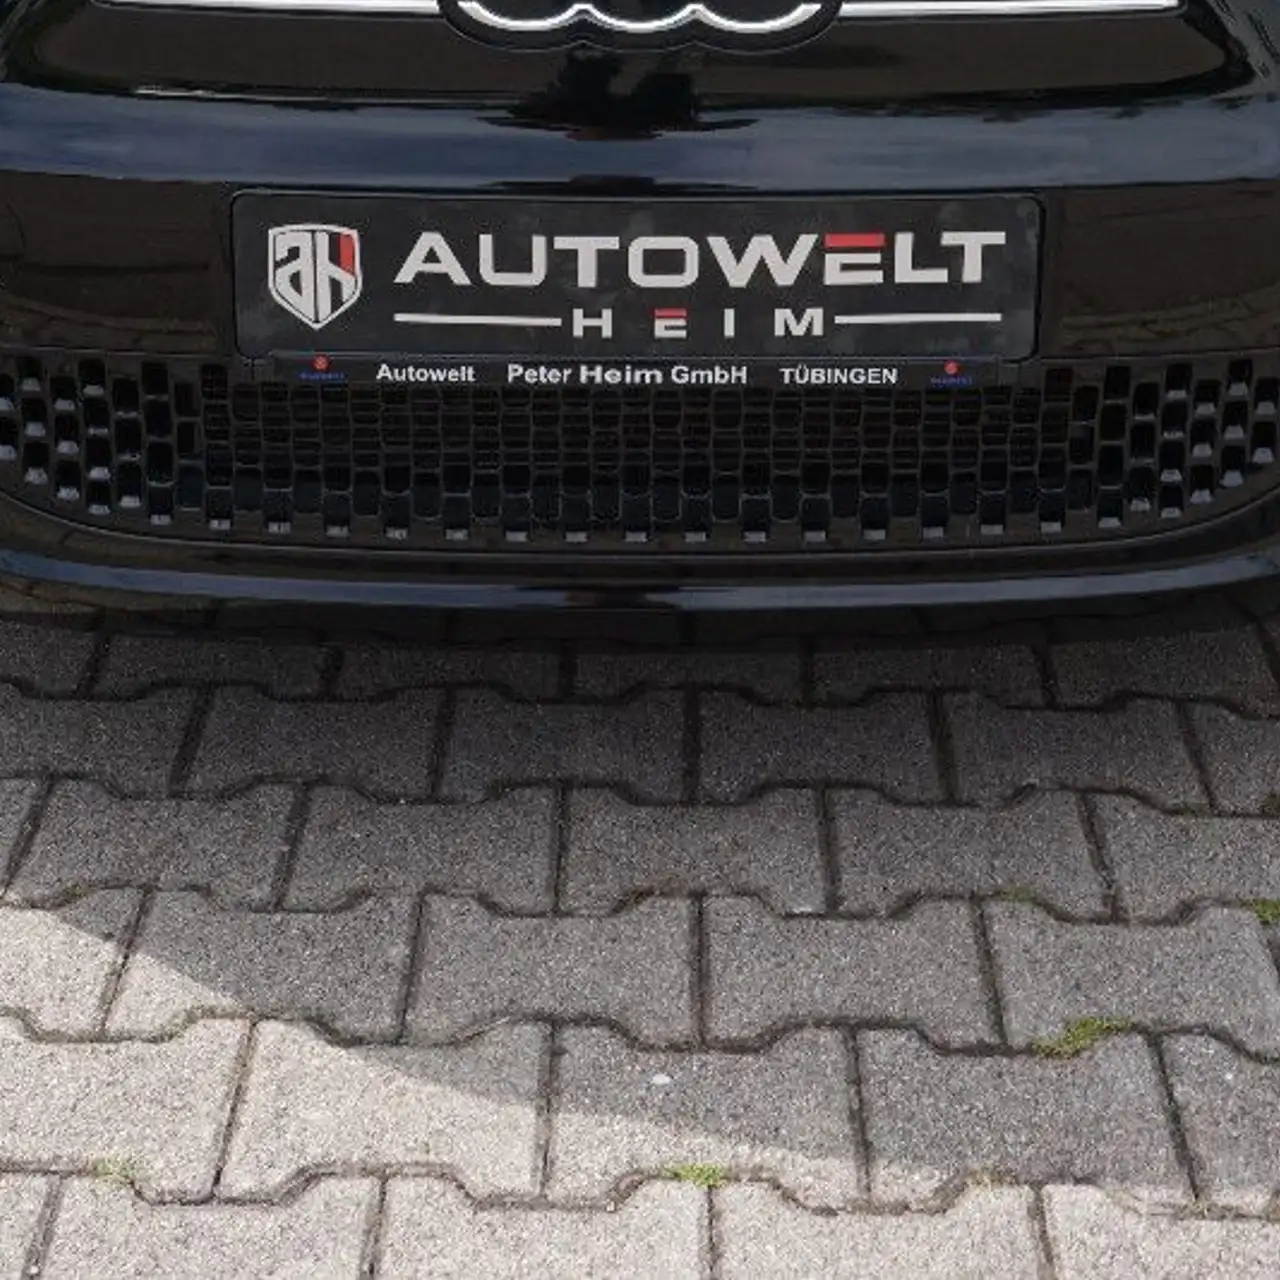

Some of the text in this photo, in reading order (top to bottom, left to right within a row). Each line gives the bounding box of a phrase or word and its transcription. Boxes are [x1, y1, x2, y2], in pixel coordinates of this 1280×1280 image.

[393, 231, 1006, 288] AUTOWELT
[572, 307, 824, 338] HEIM
[375, 363, 899, 385] Autowelt Peter Heim GmbH TÜBINGEN
